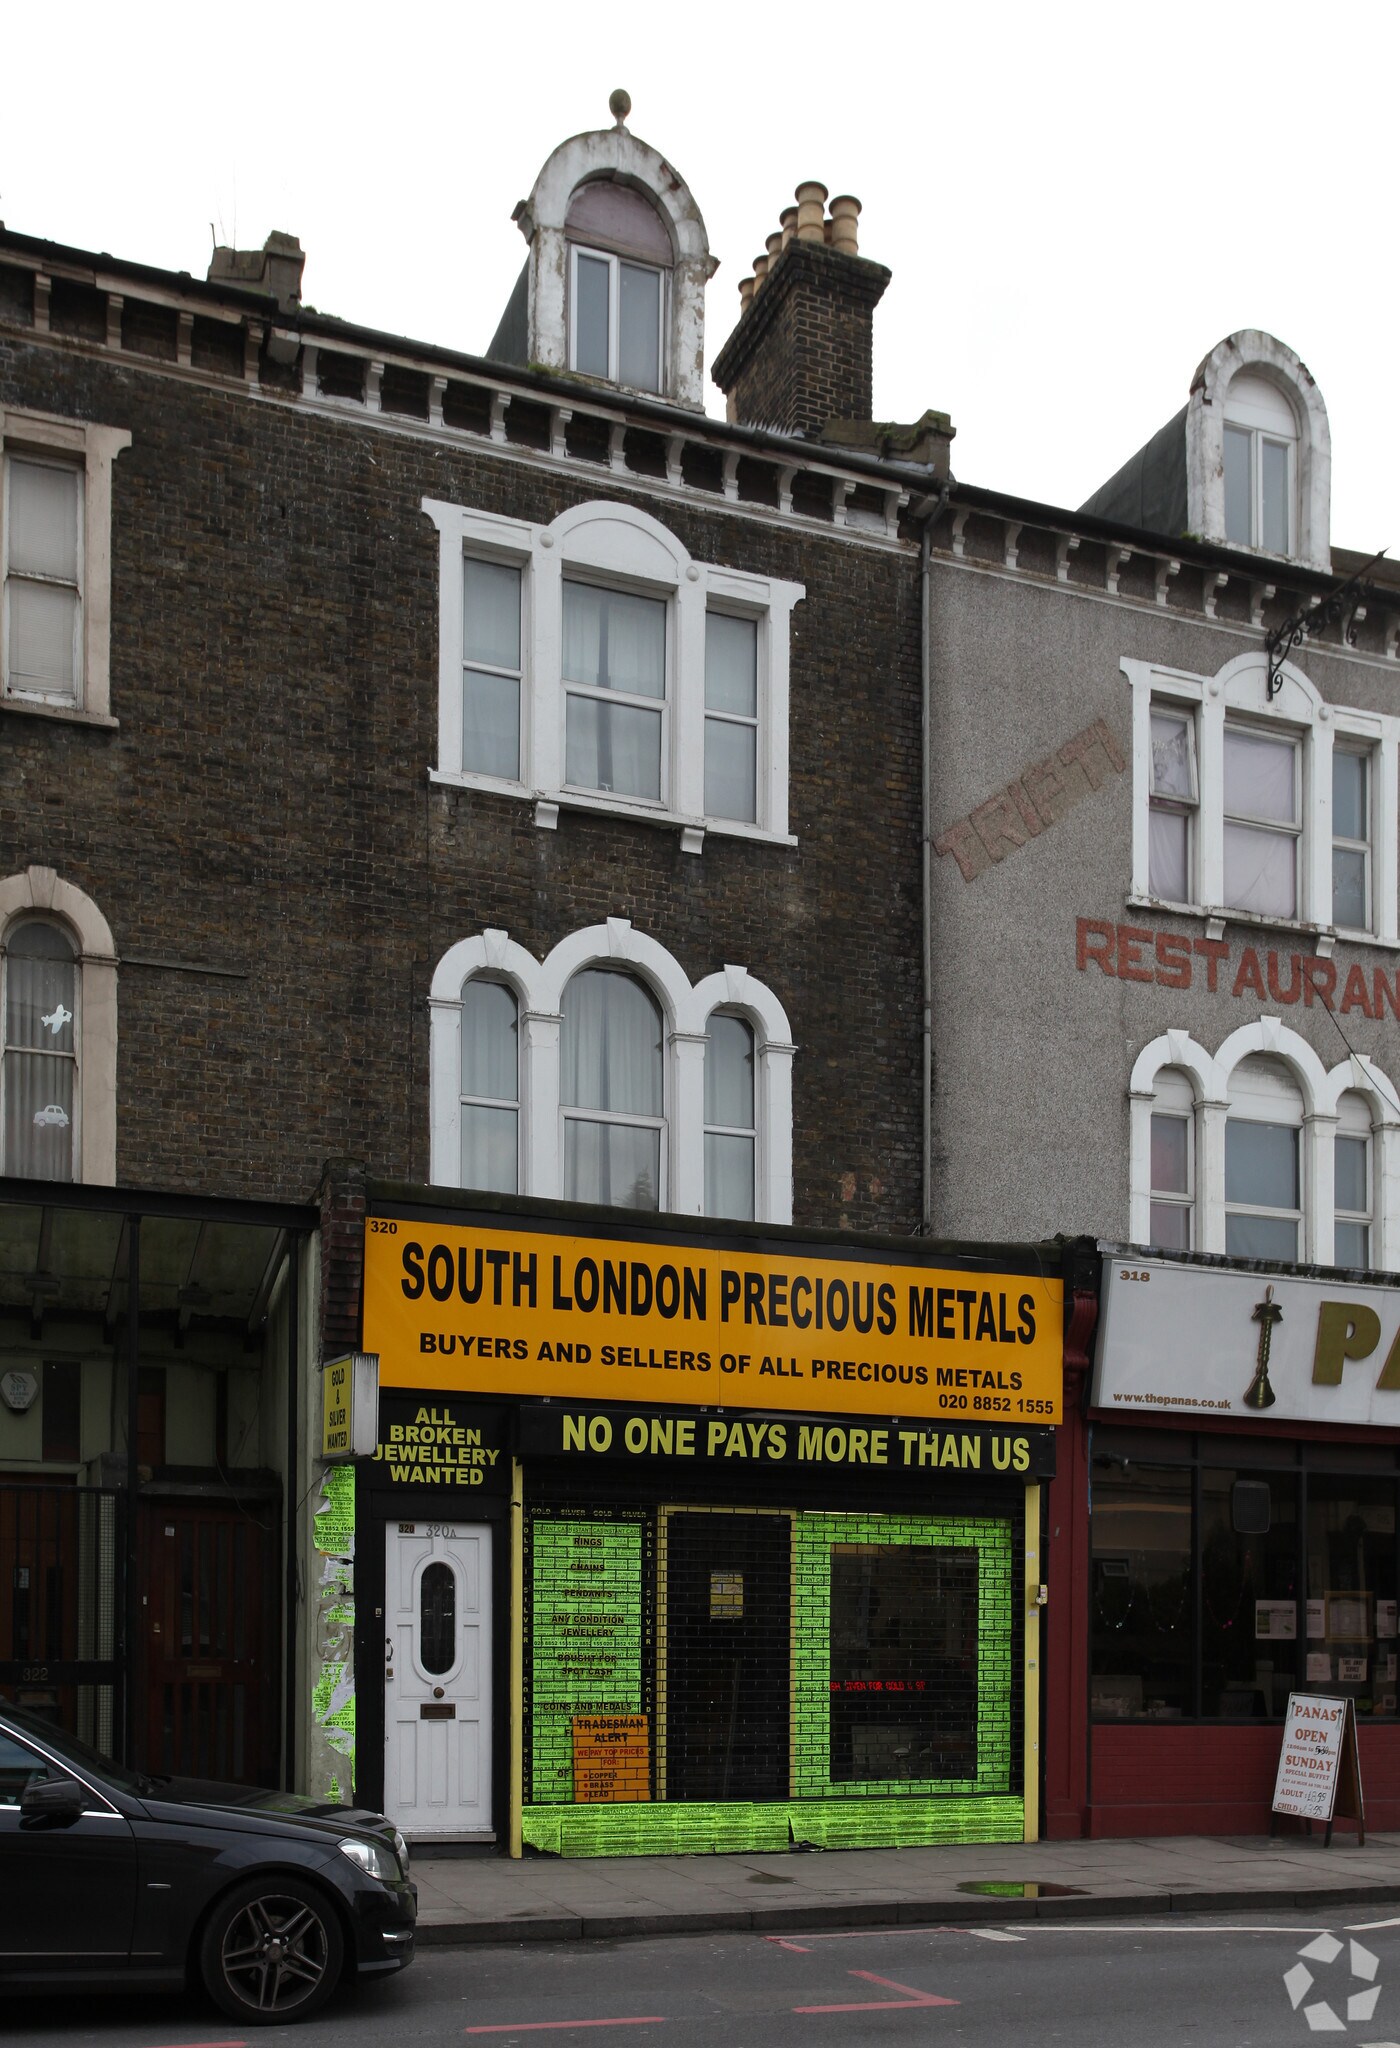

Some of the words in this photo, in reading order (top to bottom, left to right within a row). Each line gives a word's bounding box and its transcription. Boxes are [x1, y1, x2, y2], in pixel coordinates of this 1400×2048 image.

[370, 1219, 398, 1235] 320
[1119, 1270, 1150, 1282] 318
[401, 1241, 537, 1308] SOUTH
[552, 1254, 707, 1321] LONDON
[721, 1270, 896, 1336] PRECIOUS
[909, 1285, 1036, 1345] METALS
[420, 1332, 528, 1360] BUYERS
[537, 1341, 592, 1364] AND
[600, 1345, 712, 1372] SELLERS
[720, 1353, 751, 1374] OF
[759, 1356, 804, 1378] ALL
[811, 1359, 929, 1385] PRECIOUS
[936, 1368, 1023, 1391] METALS
[331, 1367, 345, 1388] GOLD
[335, 1388, 341, 1406] &
[939, 1393, 968, 1410] 020
[973, 1396, 1012, 1413] 8852
[1017, 1398, 1054, 1415] 1555
[1113, 1391, 1232, 1410] www.thepanas.co.uk
[329, 1408, 347, 1428] SILVER
[415, 1407, 456, 1426] ALL
[327, 1429, 348, 1449] WANTED
[389, 1425, 481, 1446] BROKEN
[562, 1414, 612, 1453] NO
[624, 1417, 695, 1456] ONE
[707, 1421, 787, 1460] PAYS
[797, 1425, 889, 1465] MORE
[898, 1431, 981, 1469] THAN
[991, 1437, 1030, 1472] US
[373, 1444, 500, 1466] JEWELLERY
[390, 1464, 483, 1485] WANTED
[531, 1507, 551, 1515] GOLD
[399, 1524, 415, 1533] 320
[573, 1537, 602, 1546] RINGS
[570, 1564, 605, 1572] CHAINS
[565, 1589, 613, 1598] PENDANTS
[552, 1615, 570, 1623] ANY
[574, 1616, 625, 1624] CONDITION
[561, 1628, 615, 1636] JEWELLERY
[558, 1654, 595, 1662] BOUGHT
[22, 1667, 49, 1681] 322
[845, 1681, 867, 1691] GIVEN
[868, 1681, 883, 1691] FOR
[885, 1681, 904, 1691] GOLD
[543, 1702, 572, 1710] COINS
[574, 1702, 592, 1711] AND
[596, 1702, 632, 1711] MEDALS
[1295, 1705, 1338, 1722] PANAS
[577, 1719, 644, 1729] TRADESMAN
[594, 1733, 628, 1743] ALERT
[1295, 1728, 1328, 1743] OPEN
[1285, 1755, 1334, 1772] SUNDAY
[1285, 1769, 1307, 1778] SPECIAL
[1308, 1772, 1330, 1781] BUFFET
[1280, 1788, 1303, 1798] ADULT
[1277, 1802, 1298, 1812] CHILD
